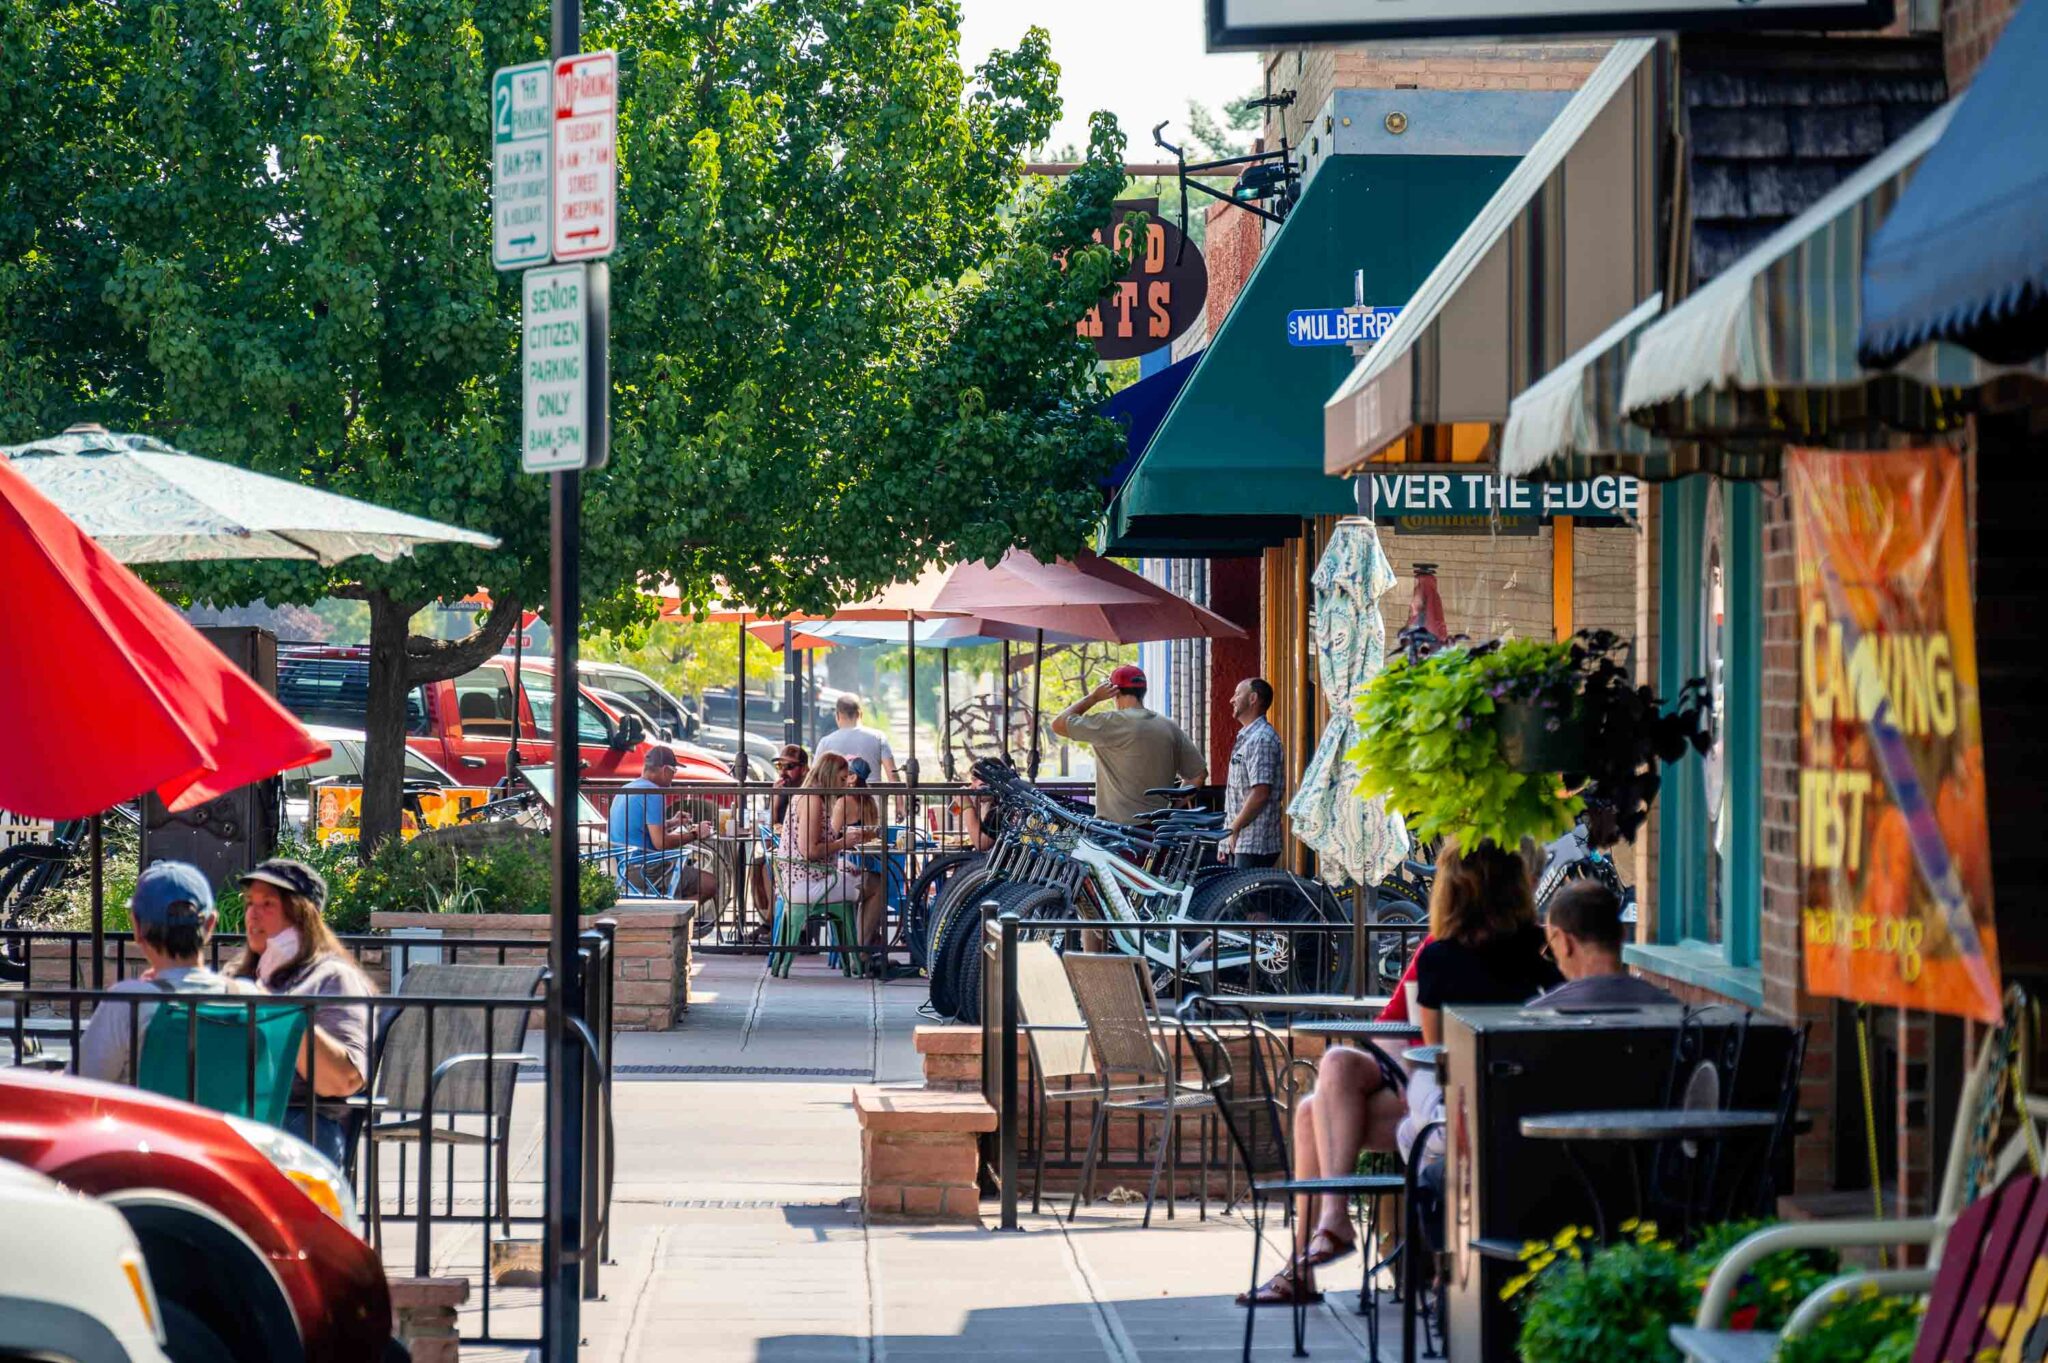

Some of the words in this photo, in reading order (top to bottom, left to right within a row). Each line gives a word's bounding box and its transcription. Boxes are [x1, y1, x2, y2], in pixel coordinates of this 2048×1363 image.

[572, 73, 612, 102] PARKING
[497, 85, 511, 134] 2
[513, 106, 548, 133] PARKING
[565, 122, 602, 142] TUESDAY
[568, 173, 598, 194] STREET
[562, 199, 605, 221] SWEEPING
[531, 285, 578, 314] SENIOR
[529, 320, 580, 349] CITIZEN
[1289, 321, 1297, 335] S
[529, 357, 579, 384] PARKING
[537, 390, 571, 417] ONLY
[1461, 474, 1531, 509] THE
[1543, 475, 1639, 509] EDGE
[6, 831, 39, 847] THE
[1225, 882, 1260, 904] MAXXIS
[1383, 880, 1419, 900] MAXXIS
